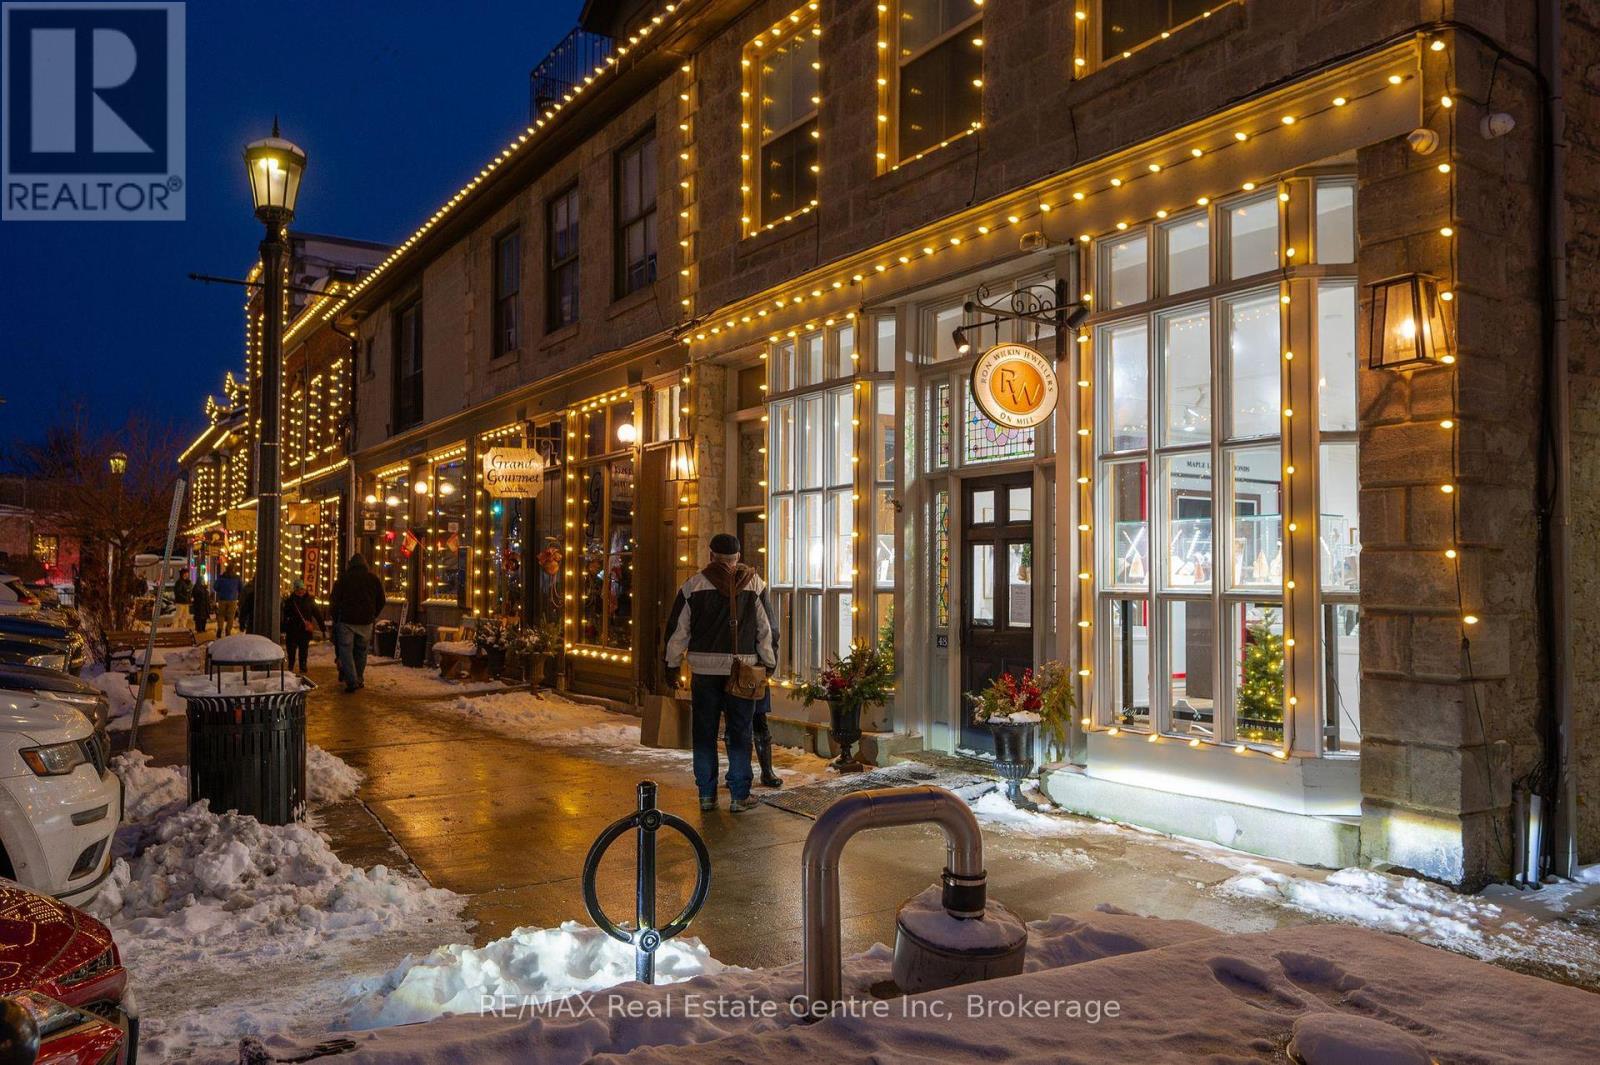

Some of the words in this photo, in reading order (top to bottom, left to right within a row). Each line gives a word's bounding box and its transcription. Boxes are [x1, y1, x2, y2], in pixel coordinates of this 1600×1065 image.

[980, 363, 992, 383] RON
[993, 349, 1020, 360] WILKIN
[1023, 351, 1054, 392] JEWELLERS
[1001, 368, 1040, 406] RW
[1000, 412, 1012, 422] ON
[1016, 416, 1034, 425] MILL
[491, 454, 534, 470] Grand
[1186, 460, 1205, 469] MAPLE
[487, 469, 539, 486] Gourmet
